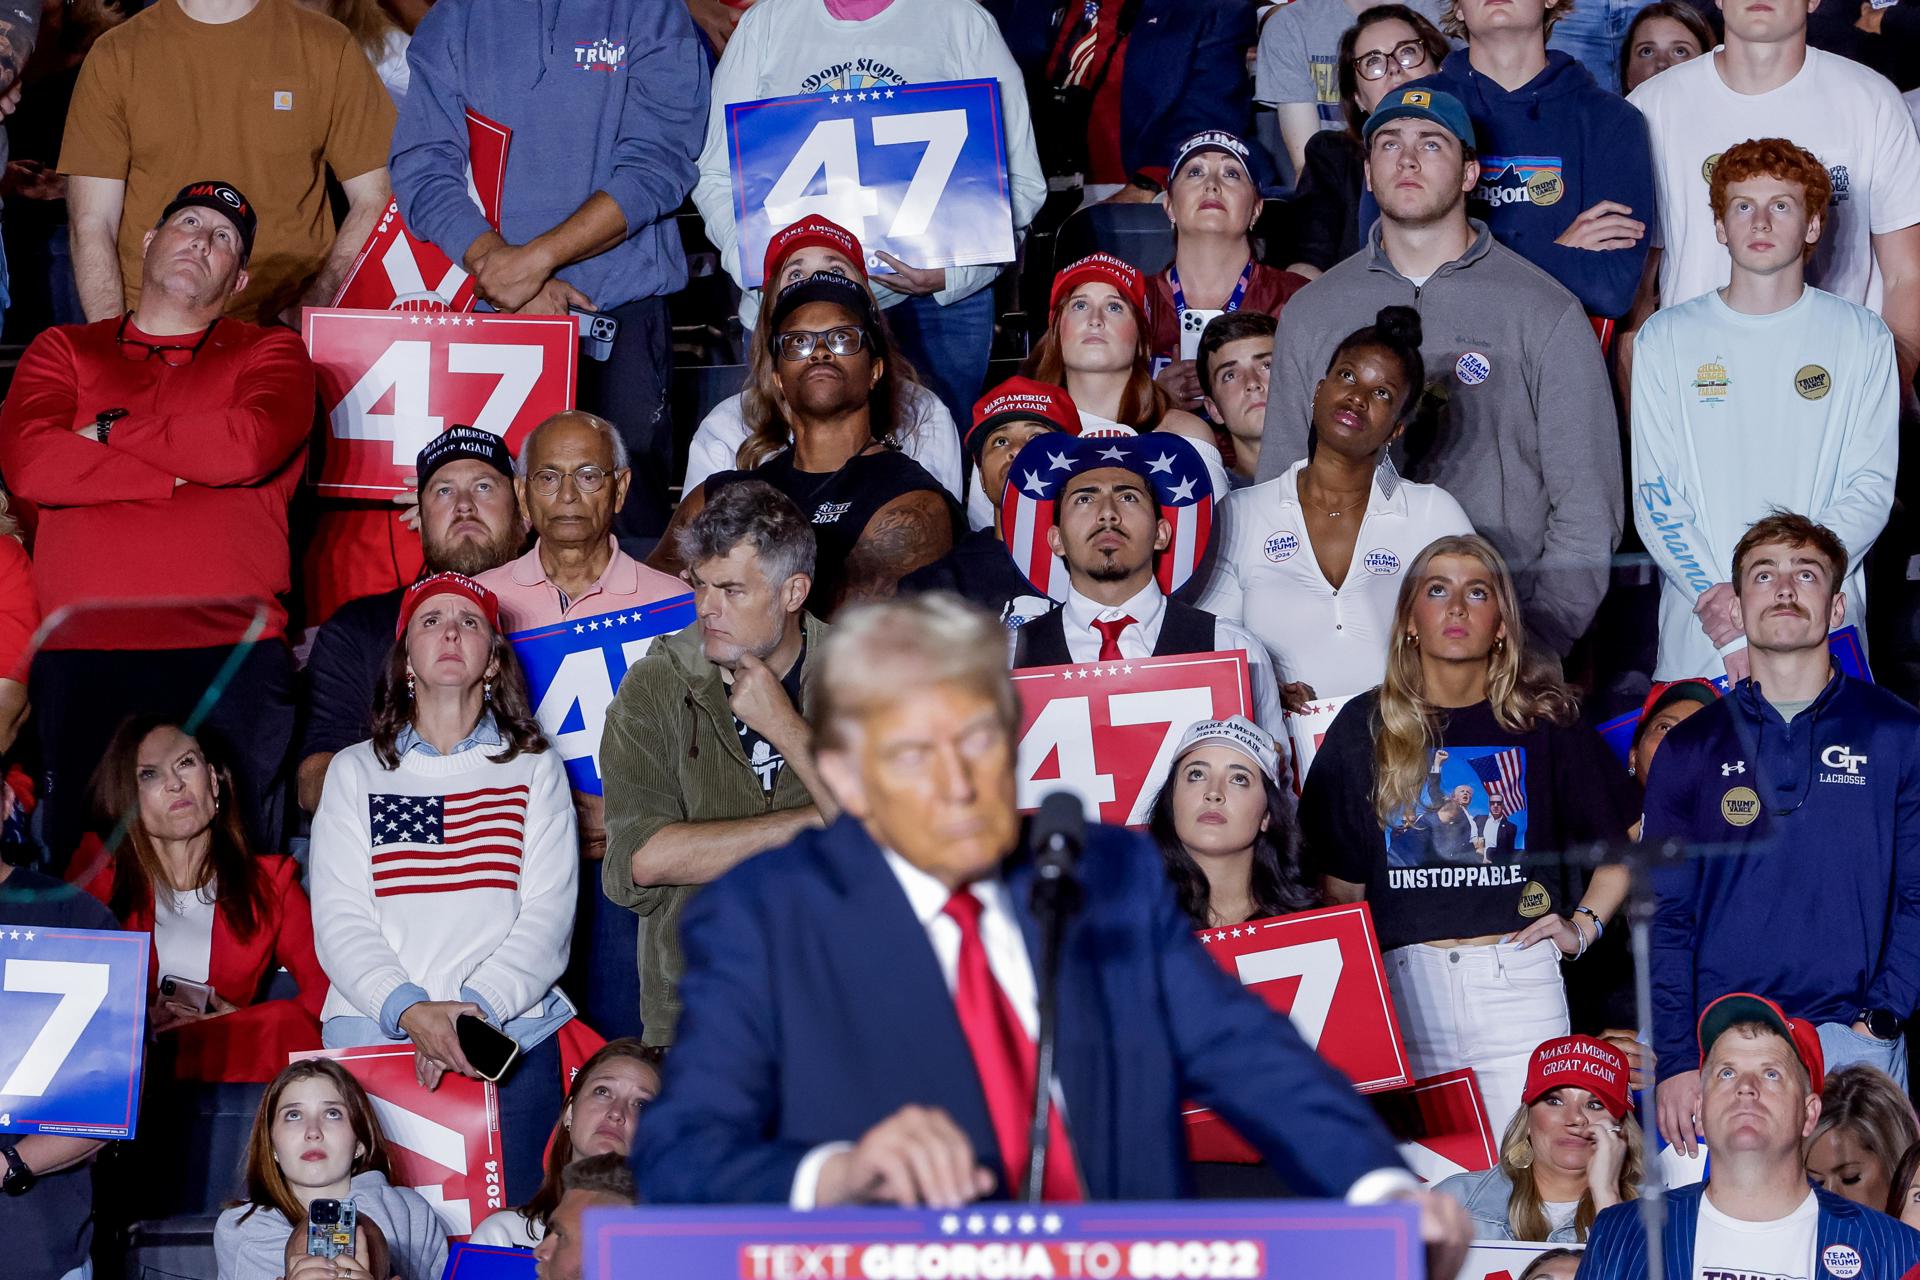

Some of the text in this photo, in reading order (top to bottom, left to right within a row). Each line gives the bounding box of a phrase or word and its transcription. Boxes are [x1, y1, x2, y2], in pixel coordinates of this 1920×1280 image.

[575, 45, 626, 65] TRUMP
[763, 108, 969, 242] 47
[1530, 178, 1558, 193] TRUMP
[1459, 357, 1486, 380] TRUMP
[1466, 353, 1489, 375] TEAM
[1797, 373, 1826, 387] TRUMP
[329, 340, 544, 466] 47
[1006, 393, 1053, 404] AMERICA
[1015, 402, 1047, 412] AGAIN
[449, 428, 497, 445] AMERICA
[459, 441, 494, 458] AGAIN
[811, 513, 841, 524] 2024
[1266, 541, 1298, 554] TRUMP
[1267, 535, 1295, 546] TEAM
[1365, 559, 1399, 568] TRUMP
[1369, 553, 1396, 562] TEAM
[1195, 721, 1224, 733] MAKE
[1234, 733, 1261, 753] AGAIN
[1017, 686, 1214, 826] 47
[1819, 773, 1866, 785] LACROSSE
[1726, 799, 1756, 808] TRUMP
[1388, 864, 1528, 889] UNSTOPPABLE.
[1538, 1041, 1622, 1070] MAKE AMERICA
[1543, 1059, 1616, 1084] GREAT AGAIN
[485, 1160, 501, 1210] 2024
[746, 1244, 852, 1280] TEXT
[861, 1244, 1053, 1280] GEORGIA
[1062, 1244, 1121, 1280] TO
[1825, 1258, 1860, 1266] TRUMP
[1826, 1251, 1856, 1259] TEAM
